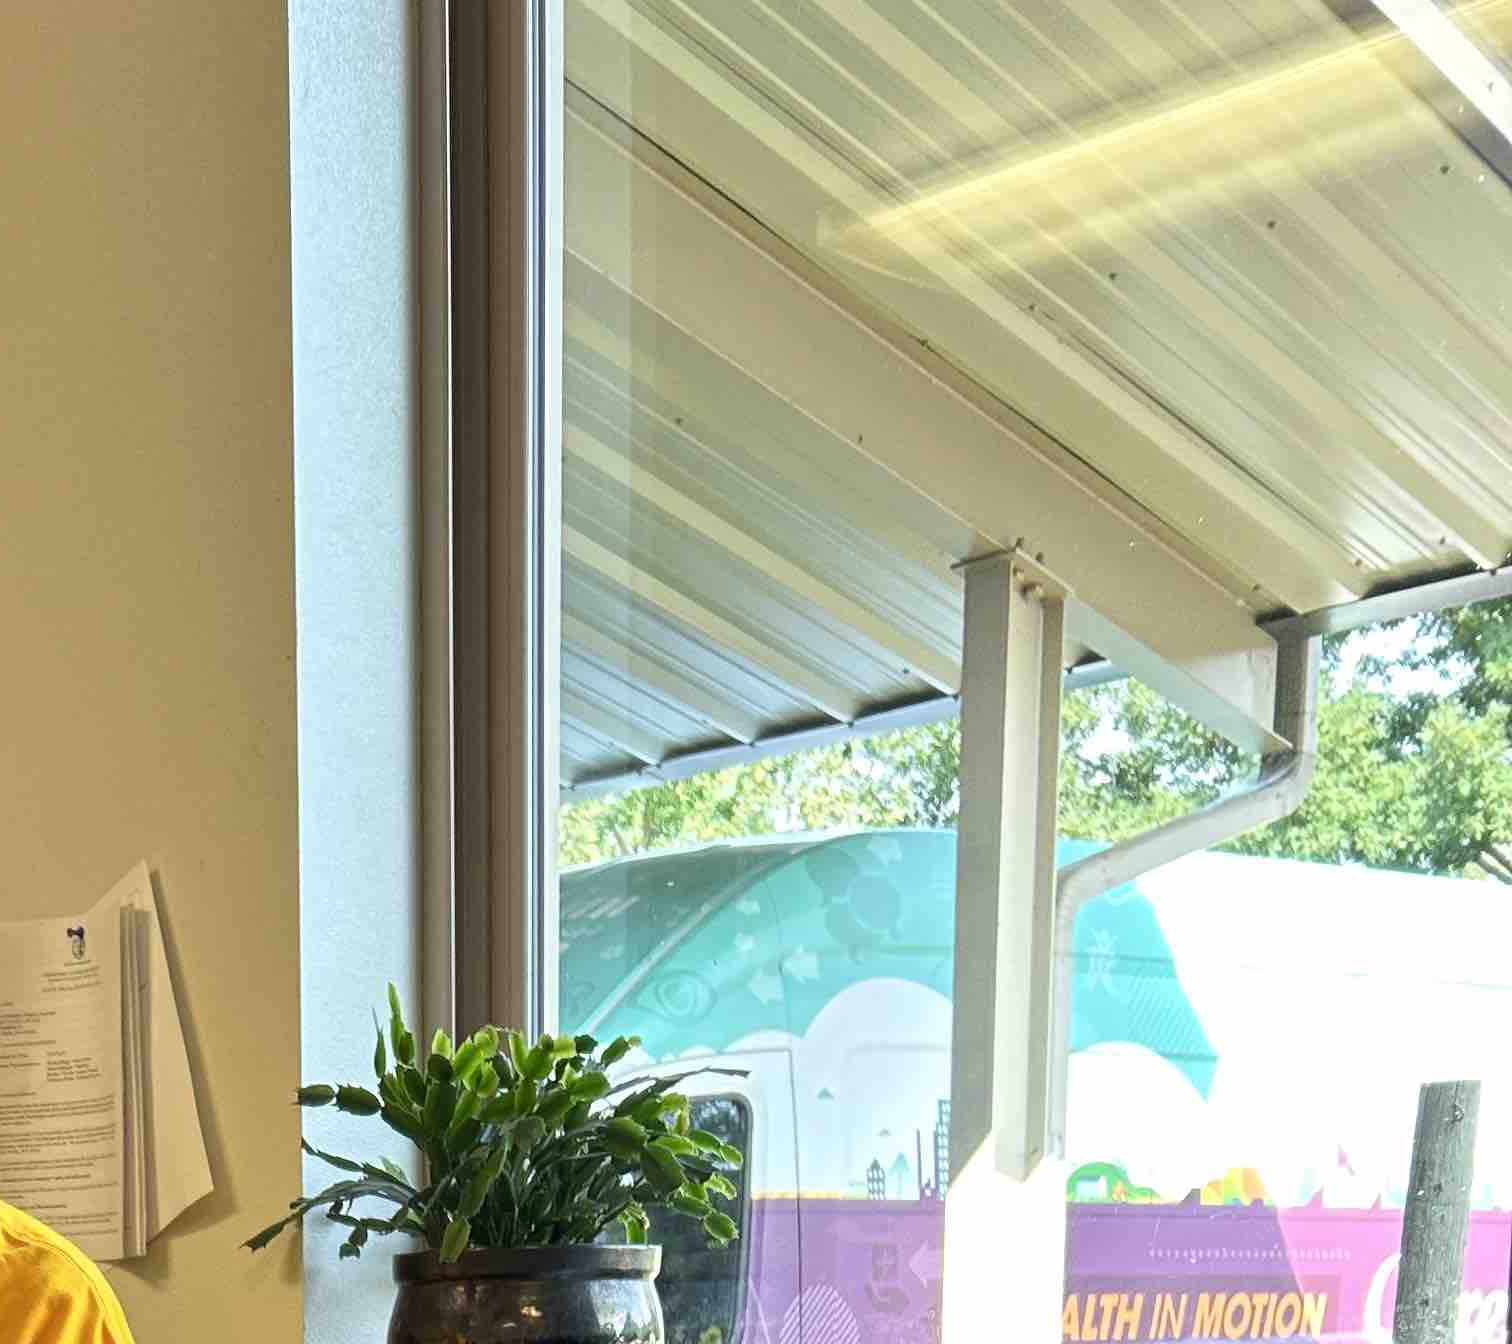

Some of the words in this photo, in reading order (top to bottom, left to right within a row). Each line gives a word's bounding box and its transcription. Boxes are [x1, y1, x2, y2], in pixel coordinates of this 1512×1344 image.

[1061, 1294, 1140, 1341] ALTH
[1149, 1294, 1188, 1340] IN
[1192, 1293, 1327, 1339] MOTION
